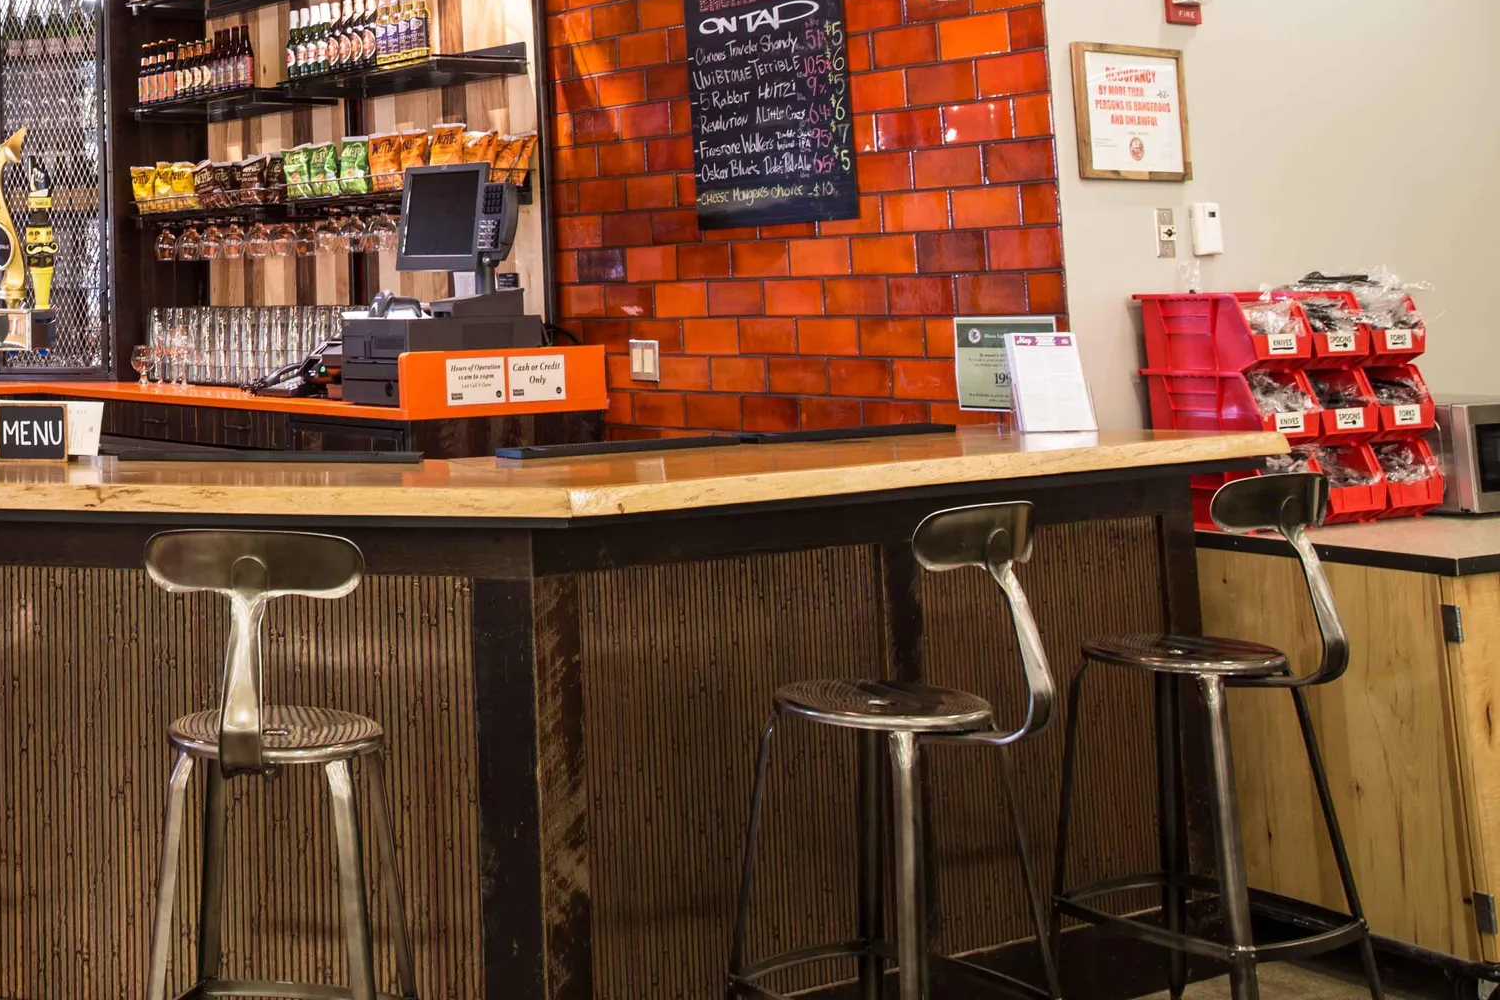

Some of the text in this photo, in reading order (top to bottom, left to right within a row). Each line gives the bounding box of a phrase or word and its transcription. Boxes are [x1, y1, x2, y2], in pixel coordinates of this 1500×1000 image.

[699, 0, 820, 35] ON TAP
[1178, 10, 1196, 19] FIRE
[1098, 85, 1107, 95] BY
[1108, 85, 1126, 96] MORE
[1095, 99, 1125, 110] PERSONS
[1133, 100, 1171, 113] DANGEROUS
[1110, 114, 1158, 127] AND UNLAWFUL
[1273, 338, 1293, 347] KNIVES
[1329, 335, 1352, 345] SPOONS
[1390, 334, 1407, 342] FORKS
[450, 363, 501, 372] Hours of Operation
[512, 363, 530, 372] Cash
[539, 361, 561, 371] Credit
[528, 375, 547, 385] Only
[1338, 412, 1361, 421] SPOONS
[1398, 410, 1416, 418] FORKS
[1279, 417, 1300, 426] KNIVES
[2, 420, 63, 446] MENU
